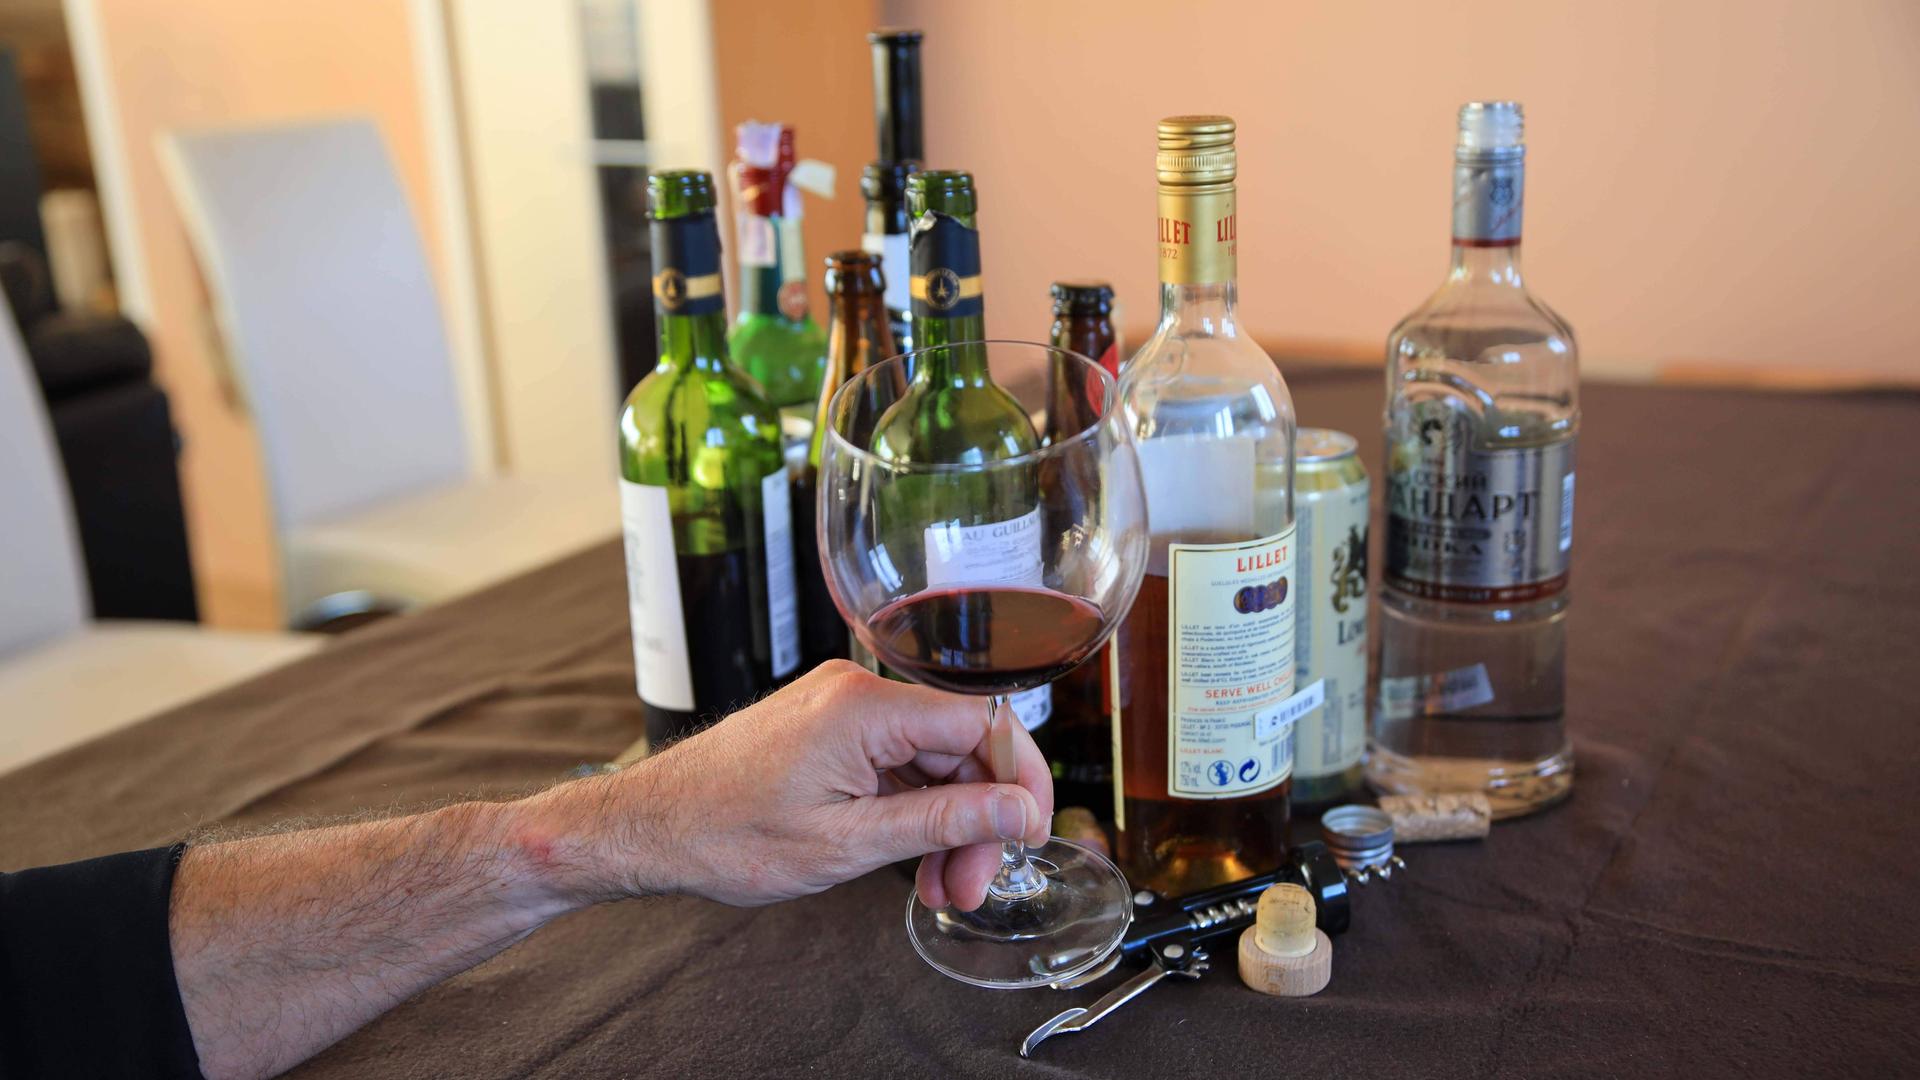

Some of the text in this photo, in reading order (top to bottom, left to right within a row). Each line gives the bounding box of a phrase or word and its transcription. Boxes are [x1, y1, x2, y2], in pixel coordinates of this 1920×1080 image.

[1236, 545, 1288, 573] LILLET
[1205, 687, 1243, 699] SERVE
[1246, 680, 1271, 694] WELL
